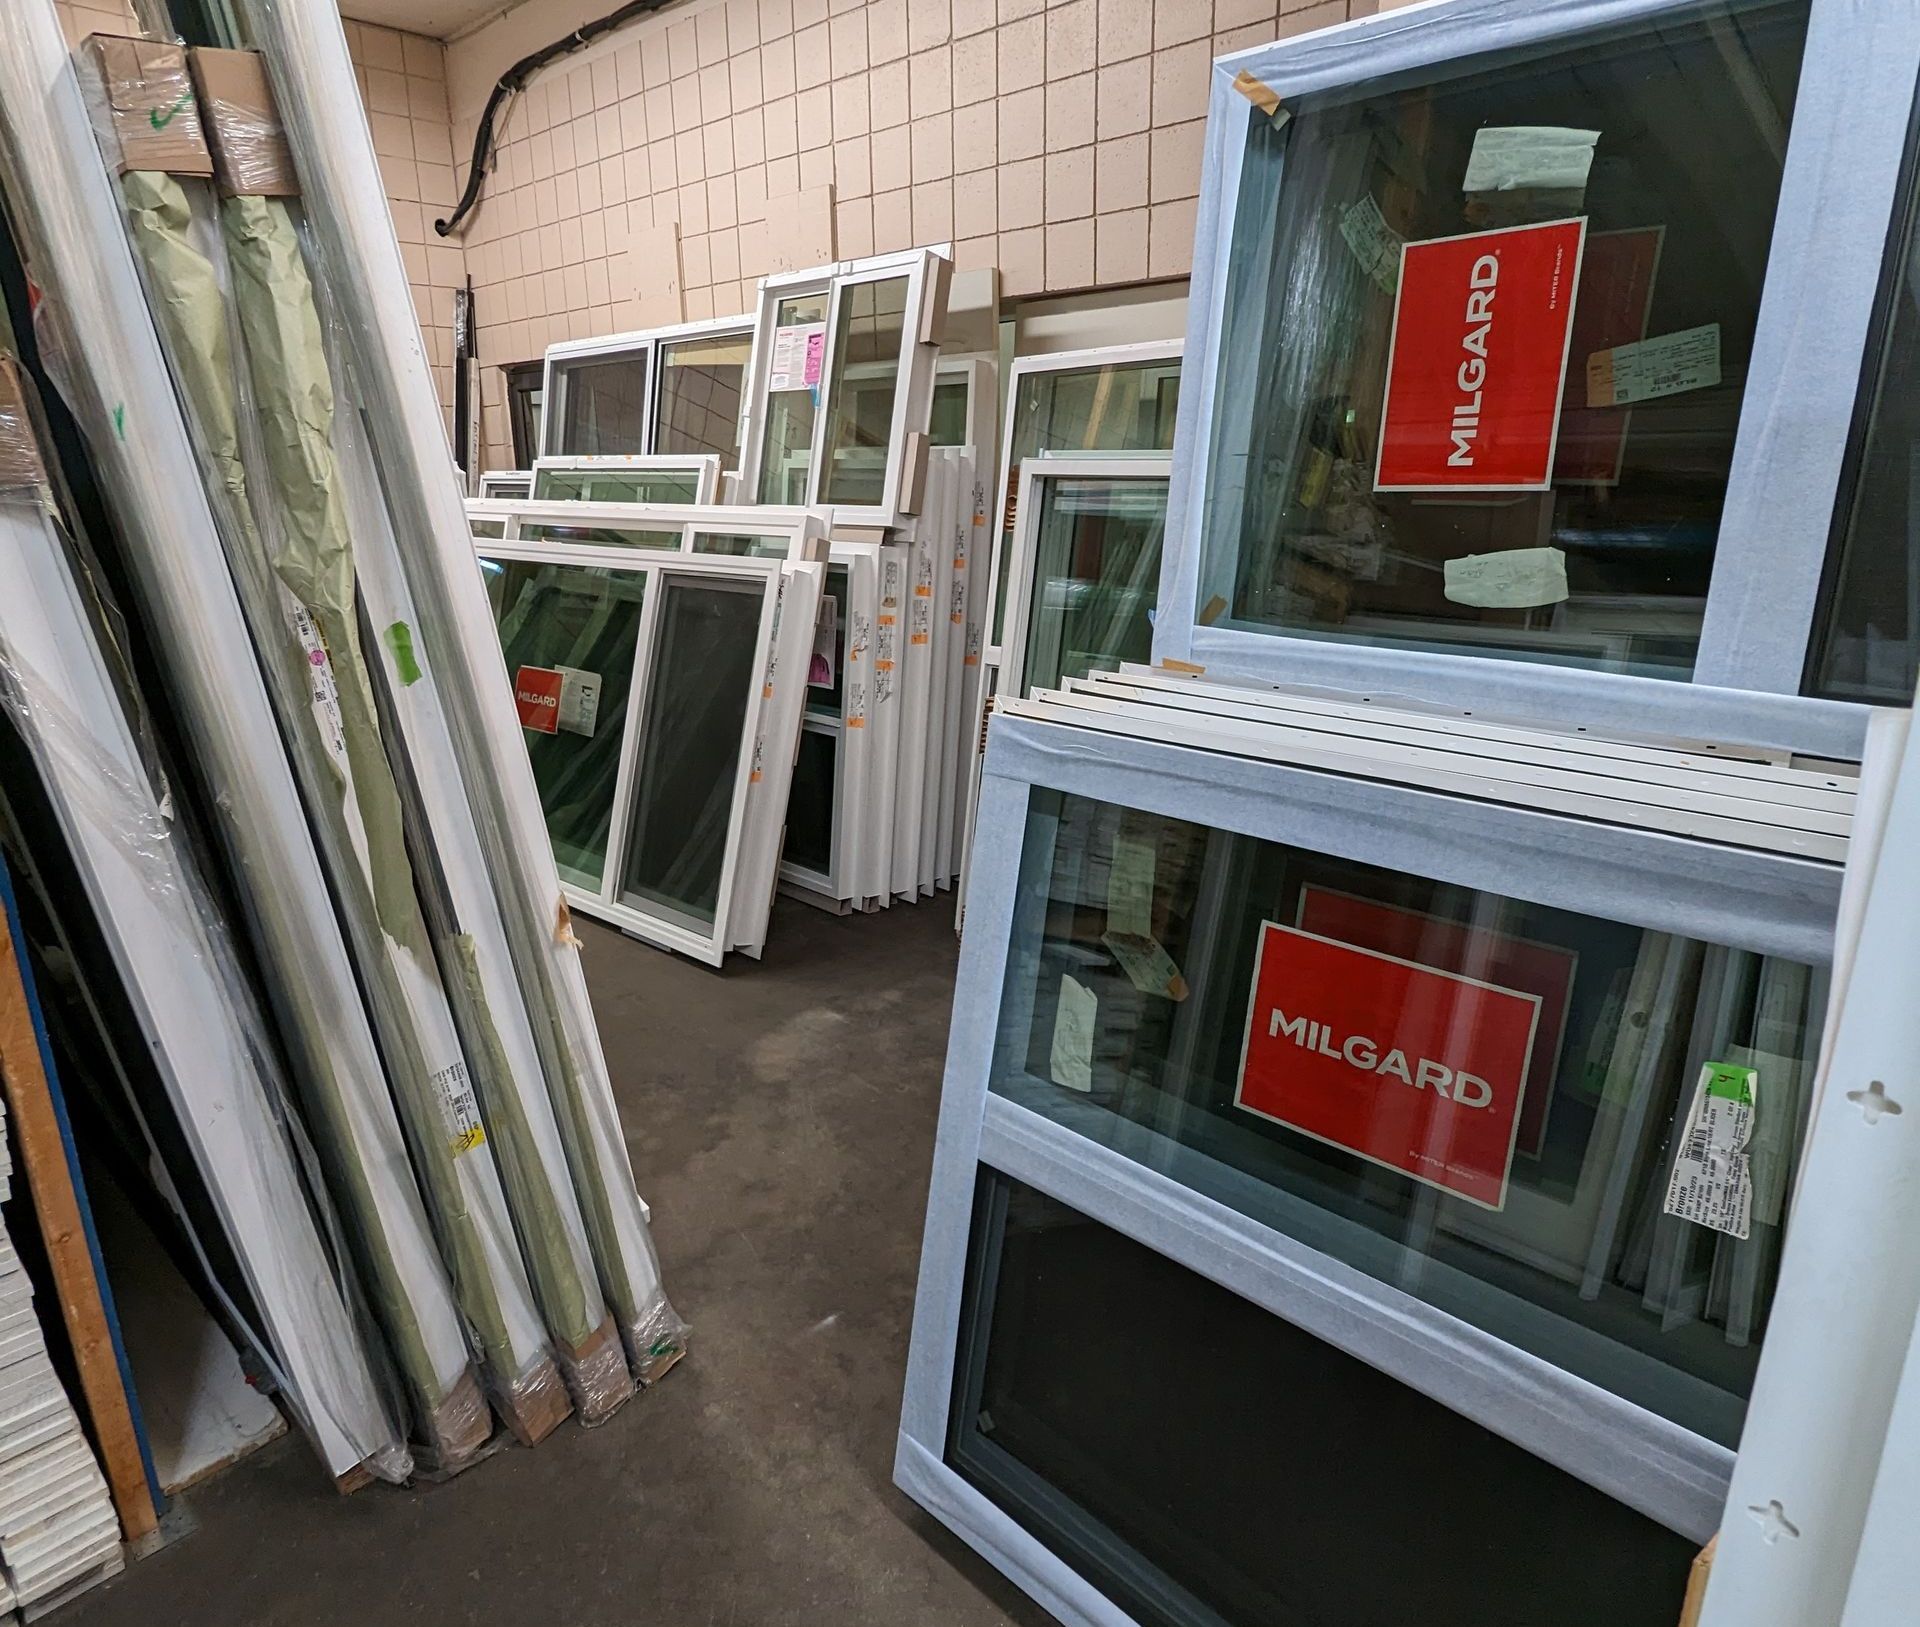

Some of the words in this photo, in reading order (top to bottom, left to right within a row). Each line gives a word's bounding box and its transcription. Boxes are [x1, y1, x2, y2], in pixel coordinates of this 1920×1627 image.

[1447, 254, 1499, 467] MILGARD
[517, 691, 557, 708] MILGARD
[1269, 1008, 1493, 1109] MILGARD
[1675, 1186, 1688, 1215] Bronze
